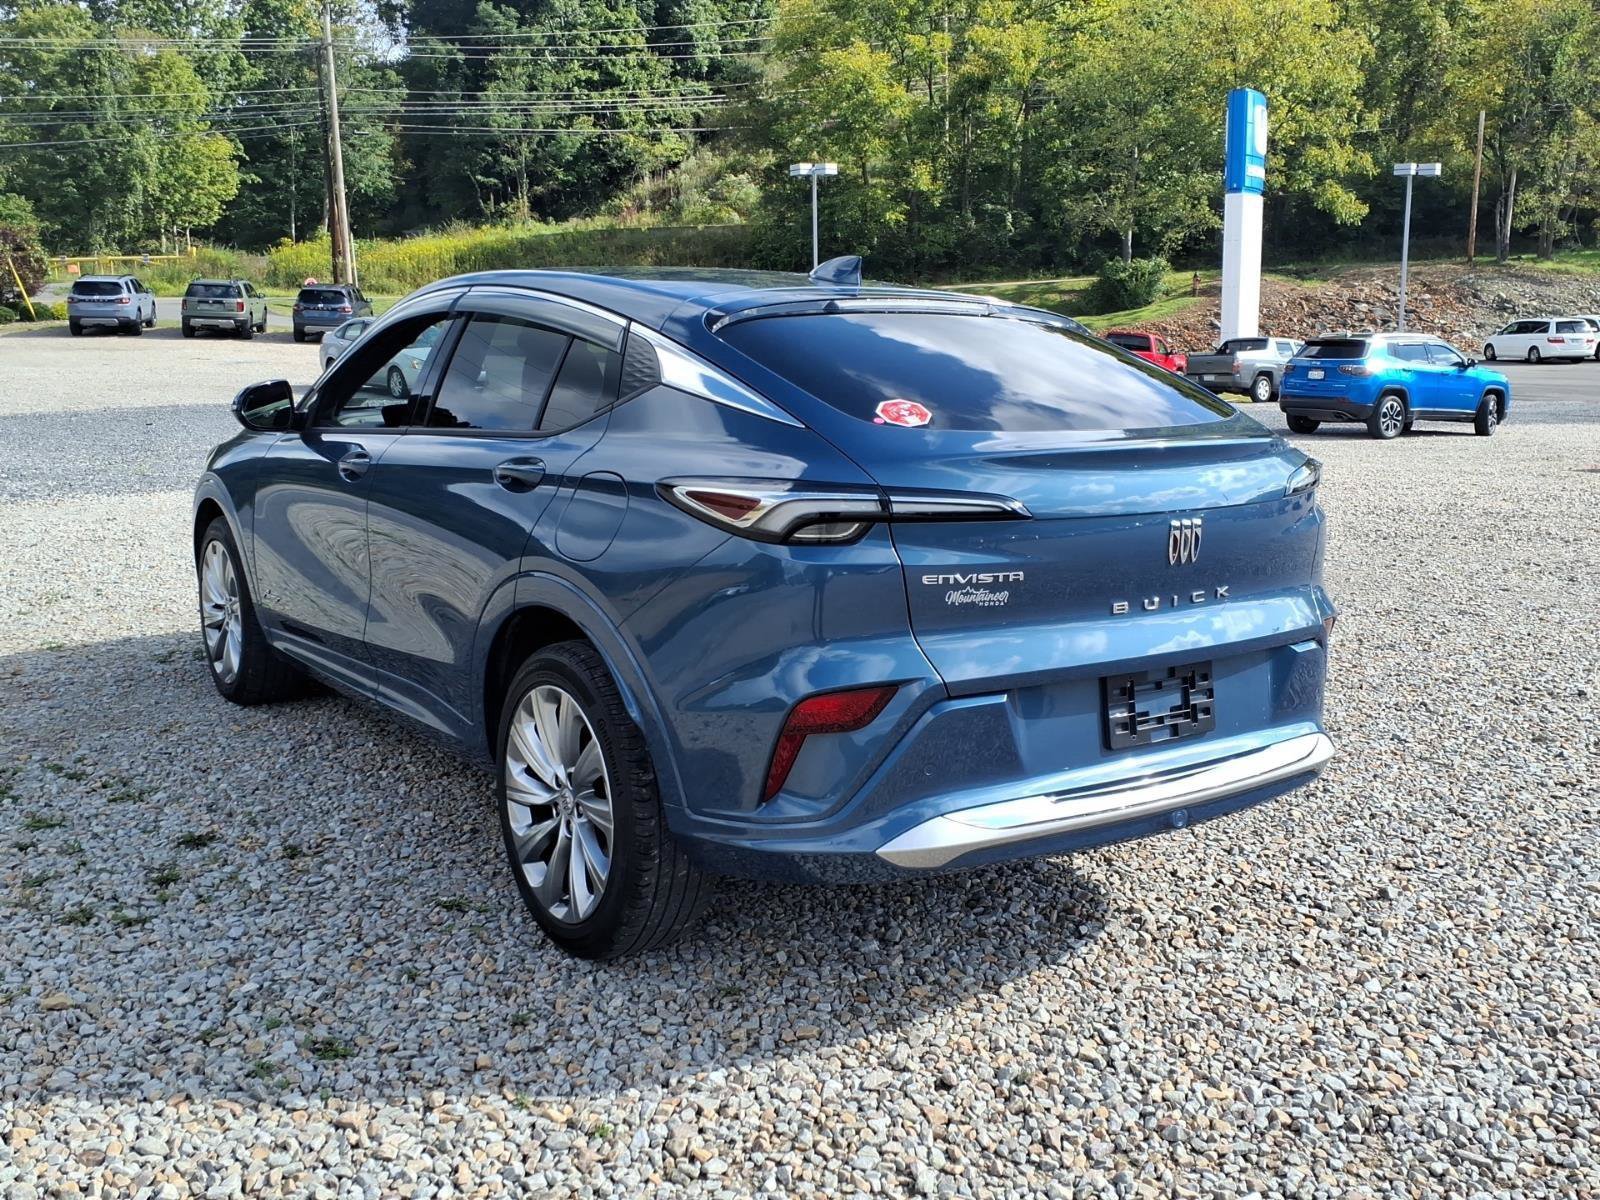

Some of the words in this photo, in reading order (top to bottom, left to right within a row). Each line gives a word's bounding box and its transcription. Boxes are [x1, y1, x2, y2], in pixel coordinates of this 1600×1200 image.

[922, 571, 1024, 585] ENVISTA
[945, 587, 1009, 606] Mountaineer
[1112, 585, 1230, 614] BUICK
